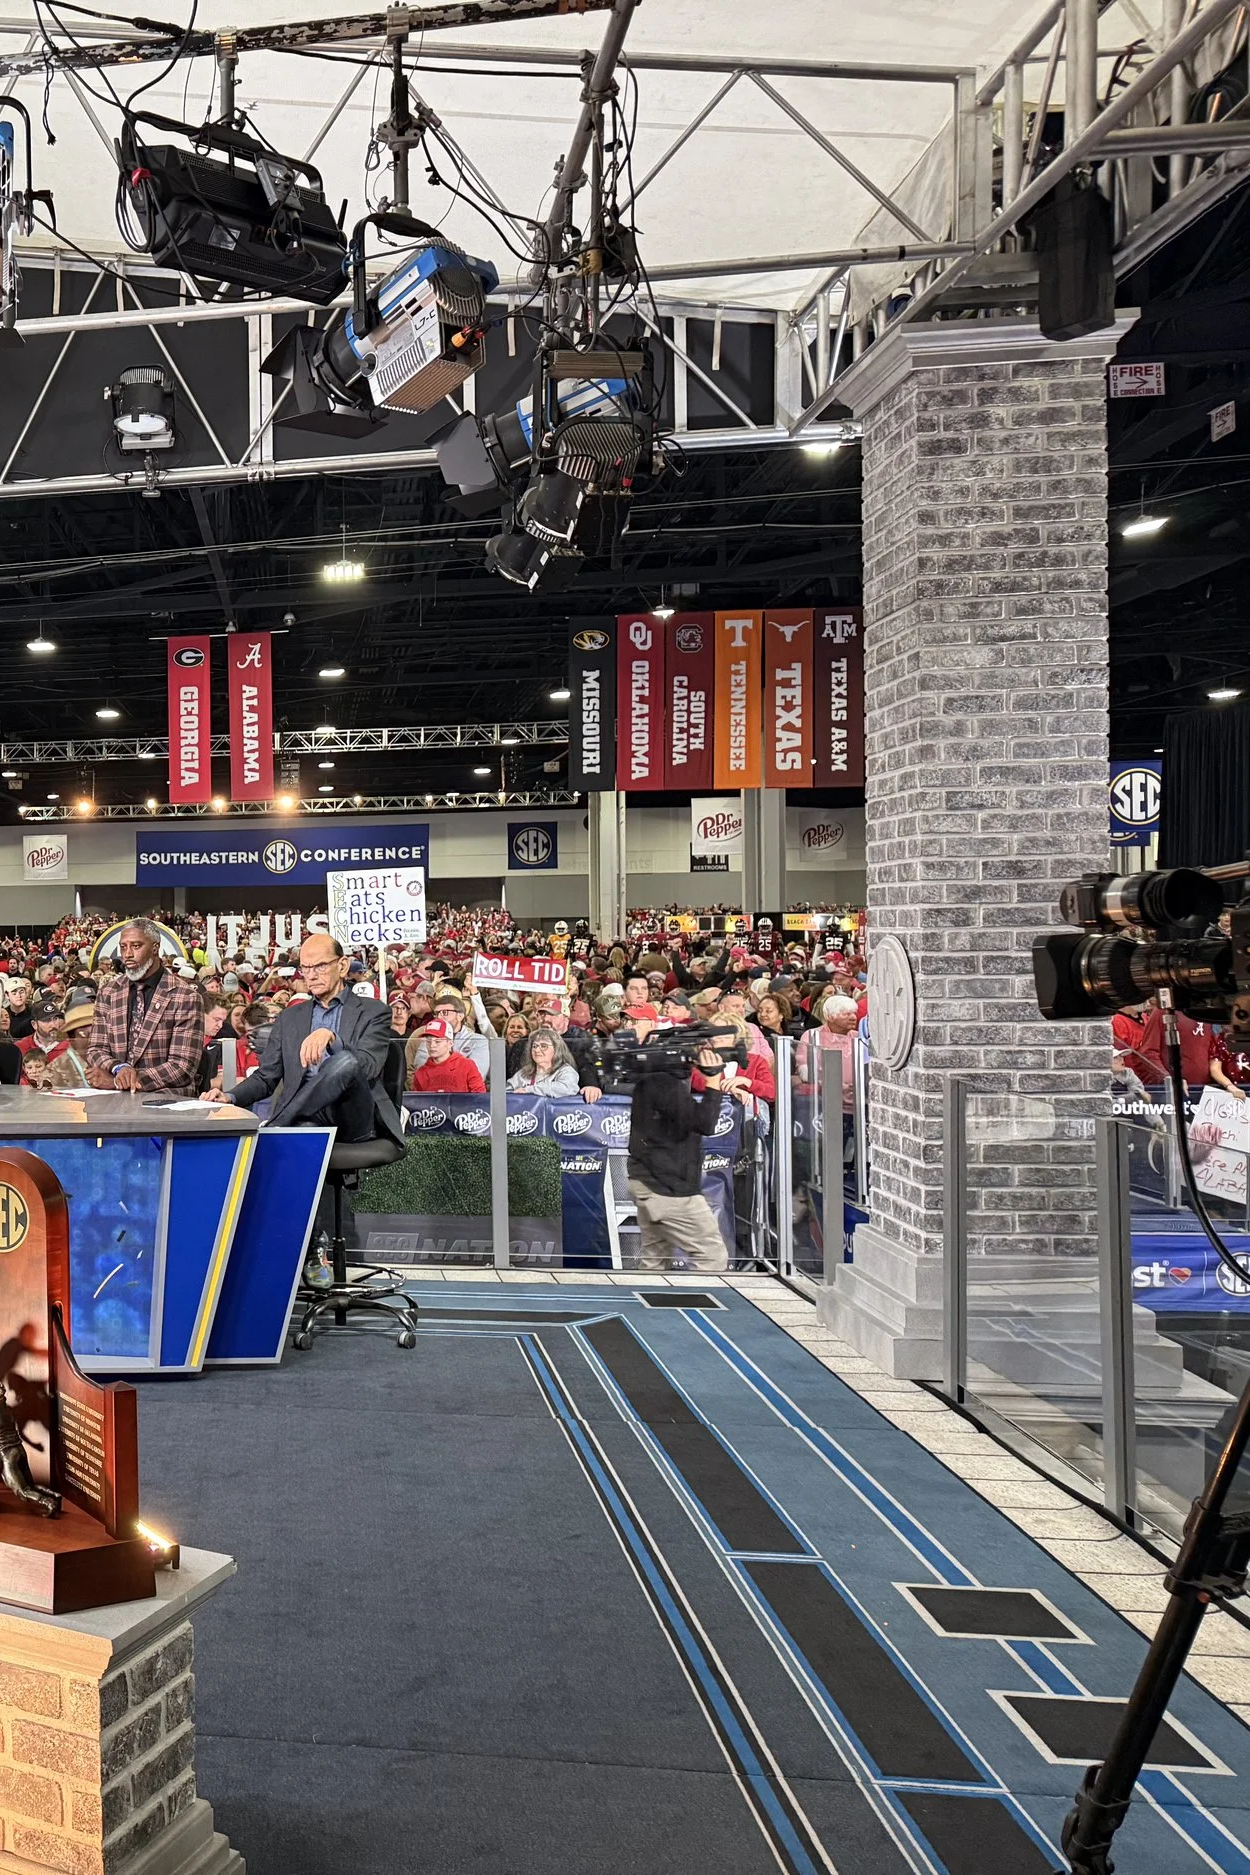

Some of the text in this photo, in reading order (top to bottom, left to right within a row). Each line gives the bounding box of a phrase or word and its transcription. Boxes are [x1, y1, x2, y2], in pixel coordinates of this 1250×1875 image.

[1120, 366, 1154, 378] FIRE
[1214, 405, 1230, 422] FIRE
[237, 642, 262, 669] A
[582, 670, 600, 774] MISSOURI
[631, 660, 649, 780] OKLAHOMA
[672, 676, 688, 766] CAROLINA
[690, 690, 705, 750] SOUTH
[730, 661, 746, 771] TENNESSEE
[776, 662, 802, 772] TEXAS
[831, 658, 848, 772] TEXAS A&M
[180, 686, 200, 787] GEORGIA
[242, 684, 260, 784] ALABAMA
[1112, 772, 1160, 820] SEC
[715, 812, 734, 826] Dr
[804, 827, 841, 848] Pepper
[817, 824, 831, 835] Dr
[40, 847, 52, 858] Dr
[517, 828, 550, 862] SEC
[29, 850, 61, 868] Pepper
[140, 843, 422, 871] SOUTHEASTERN SEC CONFERENCE
[332, 872, 402, 891] Smart
[334, 890, 386, 908] Eats
[334, 905, 422, 926] Chicken
[207, 914, 329, 949] IT JUS
[334, 924, 402, 944] Necks
[554, 940, 569, 952] 25
[574, 941, 588, 954] 25
[758, 940, 772, 950] 25
[825, 937, 844, 950] 25
[477, 954, 564, 983] ROLL TID
[1193, 1022, 1204, 1036] A
[422, 1108, 434, 1119] Dr
[1112, 1100, 1190, 1115] outhwet
[411, 1111, 444, 1128] Pepper
[456, 1114, 489, 1132] Pepper
[467, 1112, 483, 1122] Dr
[506, 1116, 536, 1134] Pepper
[514, 1114, 530, 1124] Dr
[555, 1116, 588, 1134] Pepper
[567, 1112, 582, 1124] Dr
[602, 1116, 630, 1134] Peppe
[615, 1114, 629, 1124] Dr
[560, 1162, 600, 1171] NATION
[702, 1160, 730, 1171] TION
[373, 1236, 554, 1263] SEC NATON
[1221, 1256, 1250, 1292] SE
